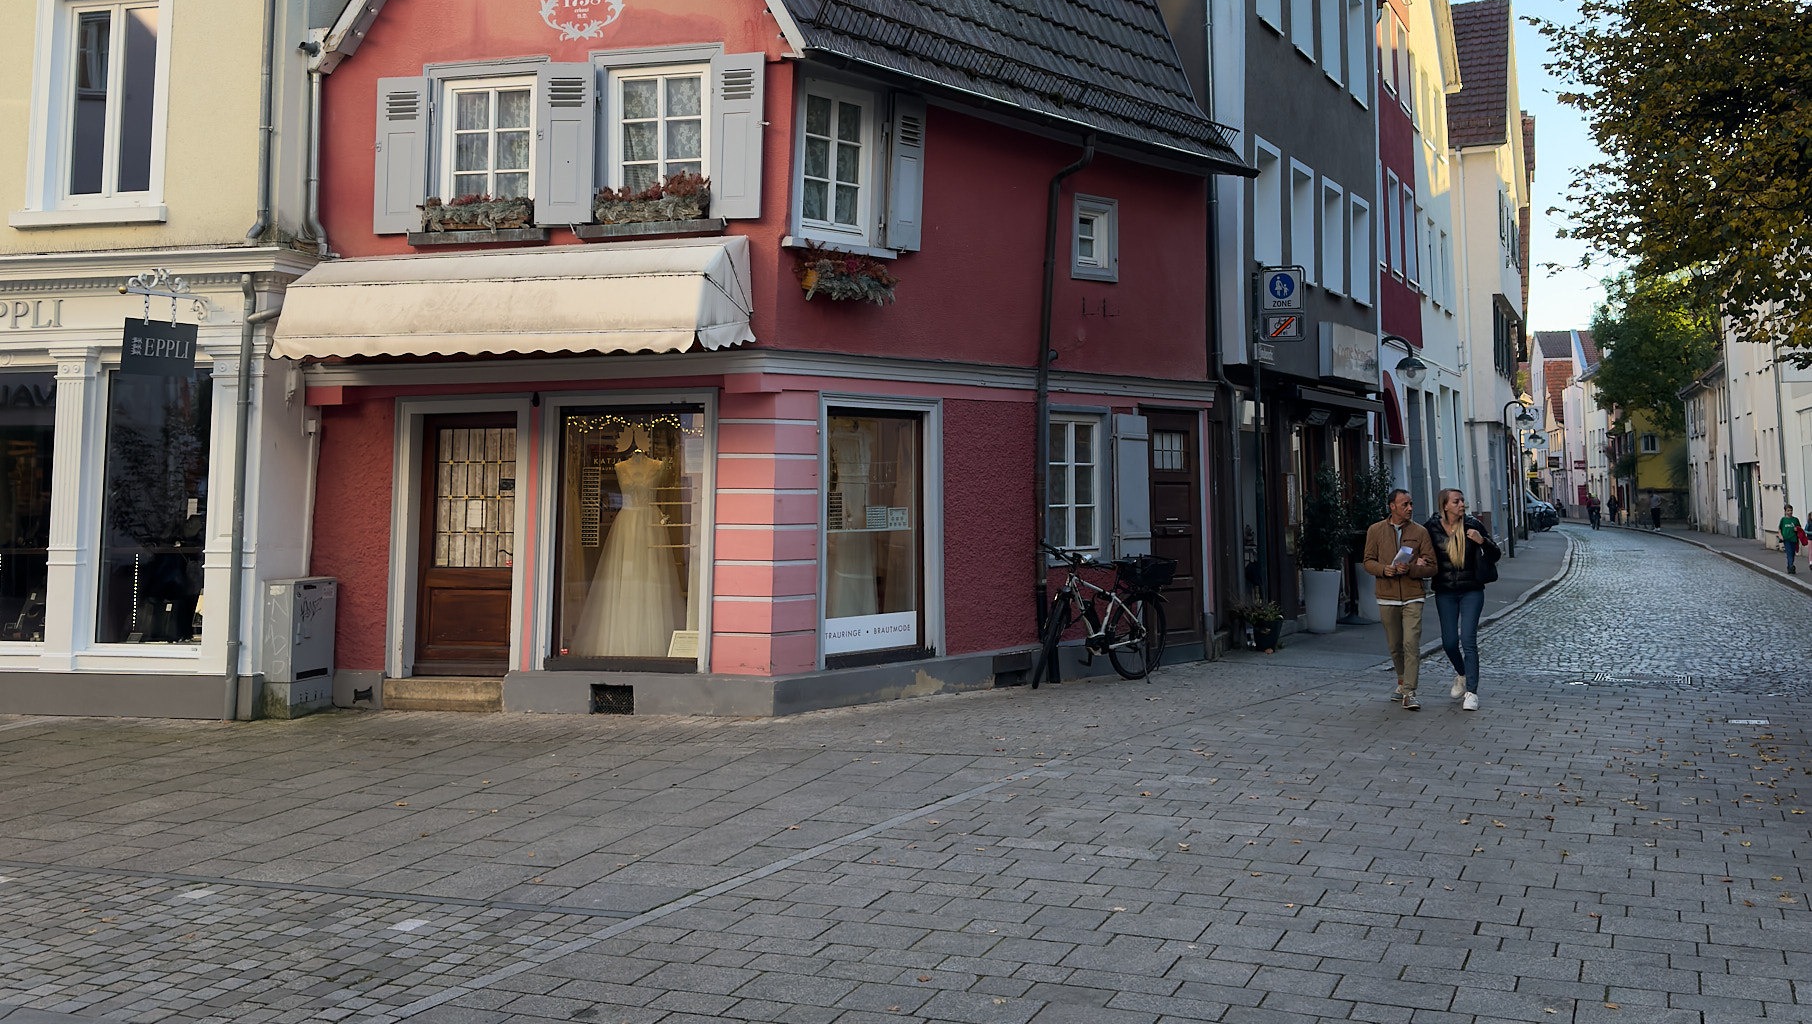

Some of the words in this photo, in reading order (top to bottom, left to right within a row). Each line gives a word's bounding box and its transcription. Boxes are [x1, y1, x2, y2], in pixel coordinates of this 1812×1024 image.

[144, 337, 190, 360] EPPLI
[825, 629, 861, 639] TRAURINGE
[873, 624, 910, 634] BRAUTMODE
